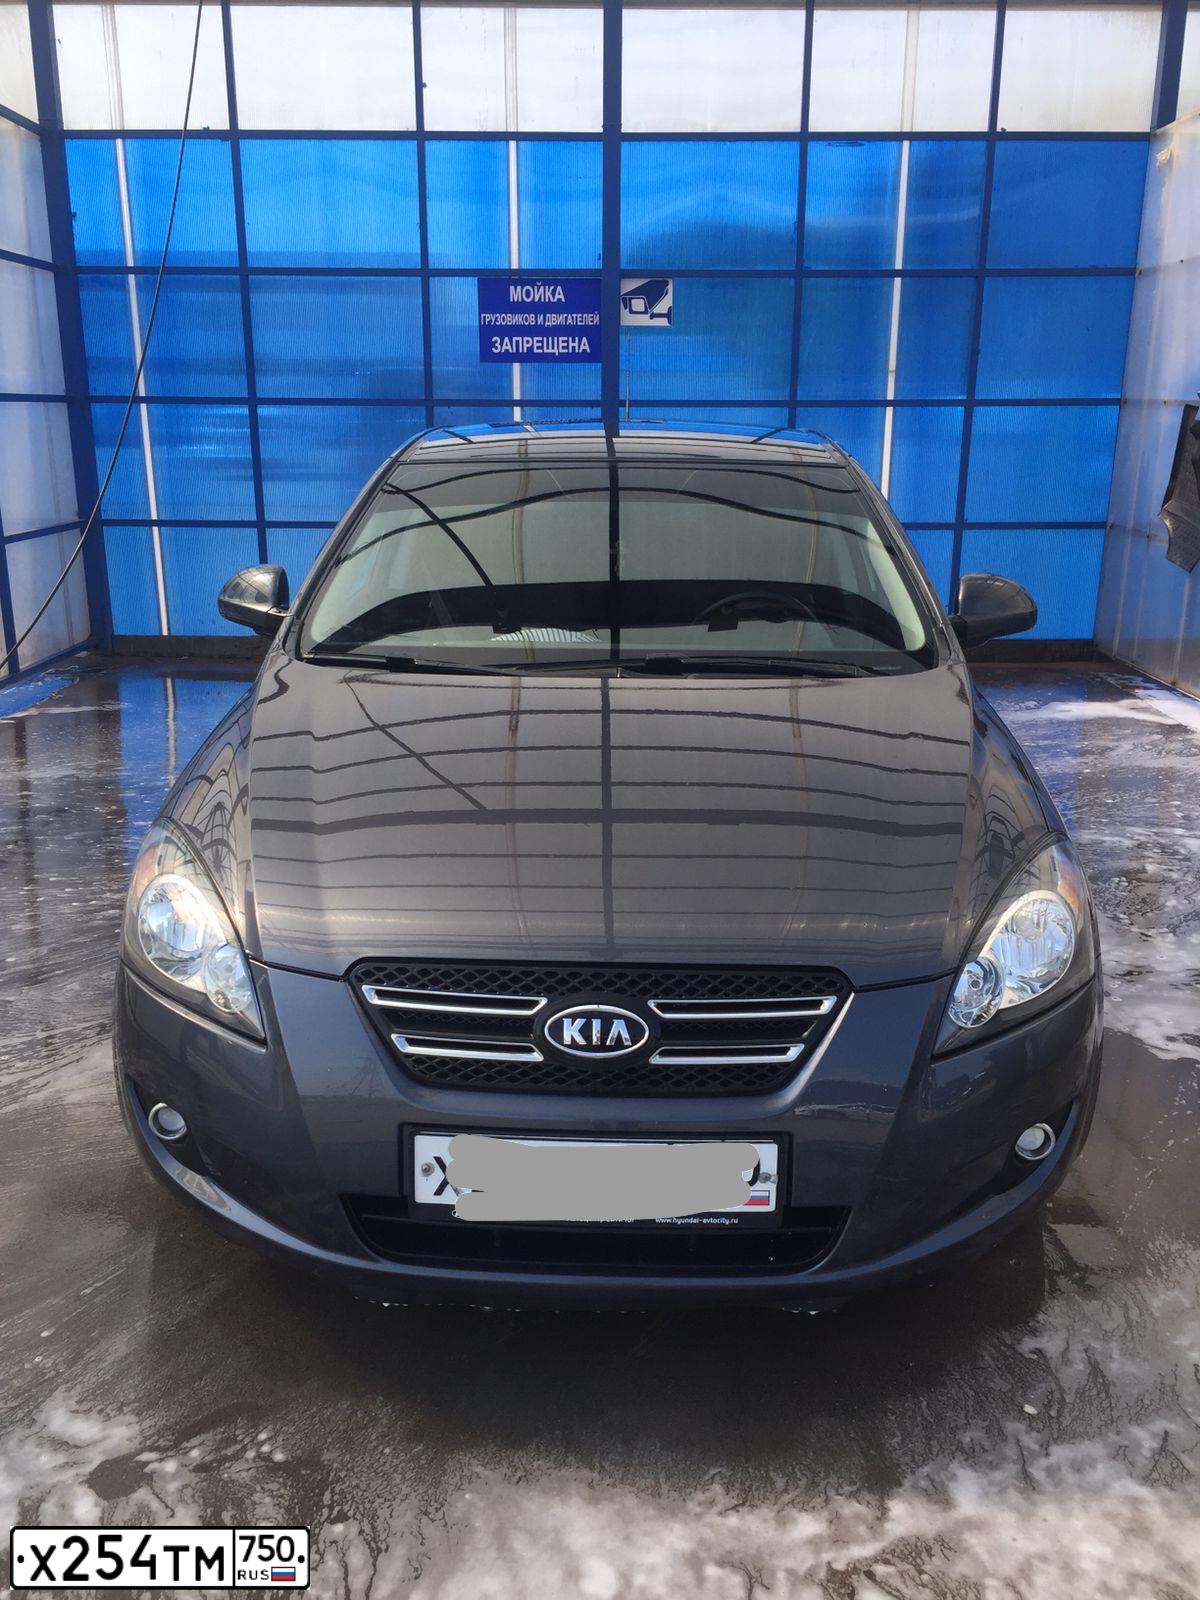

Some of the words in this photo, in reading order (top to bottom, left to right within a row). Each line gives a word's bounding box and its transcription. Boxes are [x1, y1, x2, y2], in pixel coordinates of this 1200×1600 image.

[509, 282, 565, 302] МОЙКА
[480, 313, 536, 325] ГРУЗОВИКОВ
[537, 313, 543, 325] И
[545, 312, 600, 327] ДВИГАТЕЛЕЙ
[491, 336, 590, 355] ЗАПРЕЩЕНА
[562, 1018, 632, 1045] KIA
